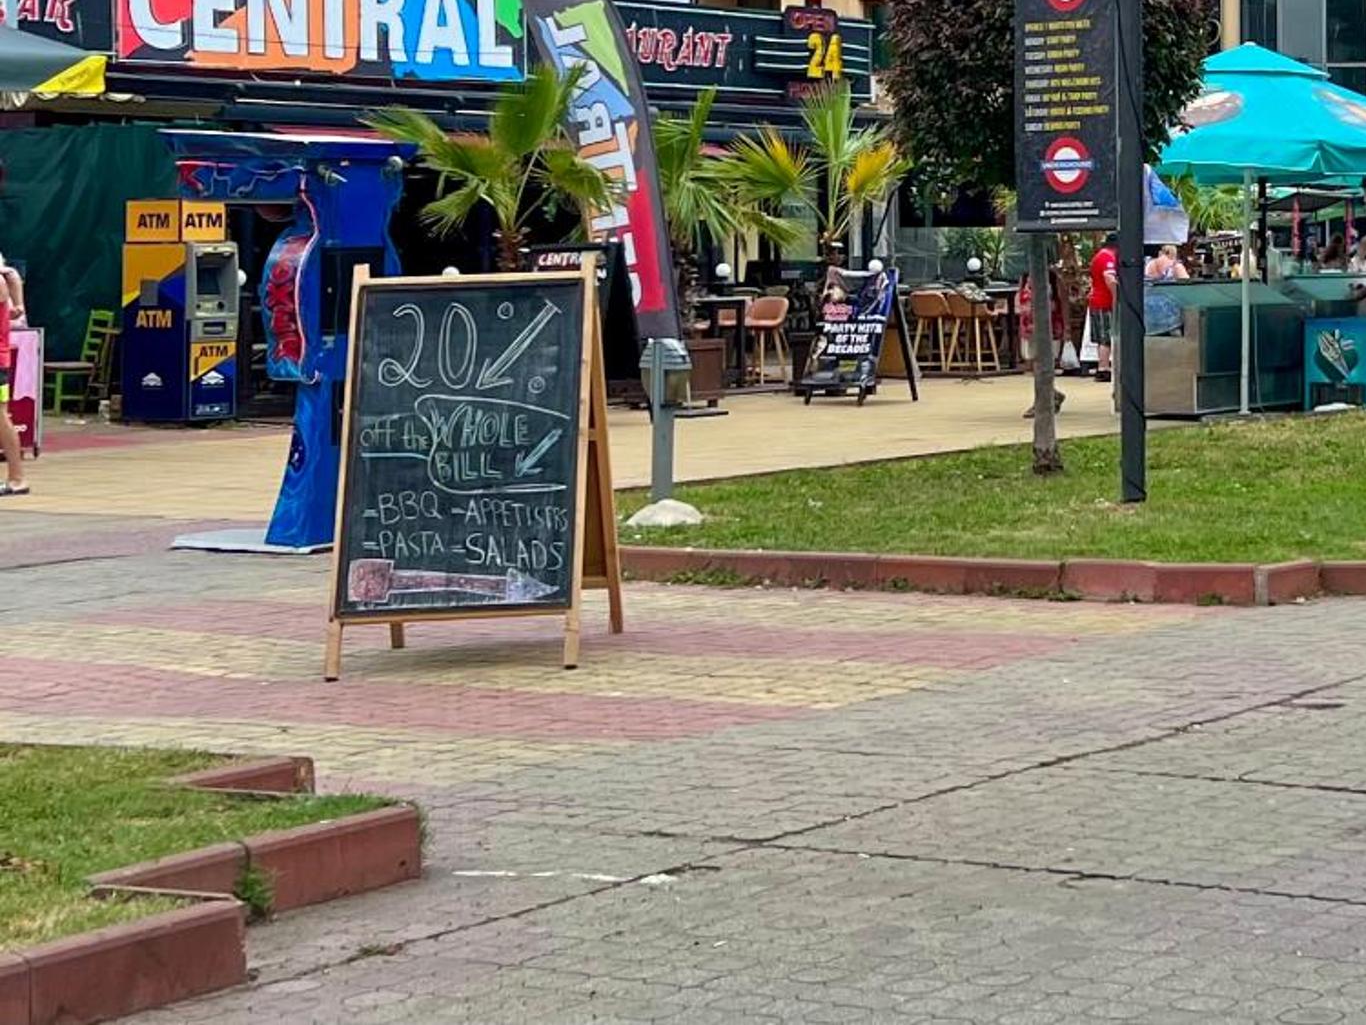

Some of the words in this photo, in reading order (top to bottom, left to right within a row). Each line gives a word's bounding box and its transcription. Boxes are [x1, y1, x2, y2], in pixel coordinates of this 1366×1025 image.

[806, 31, 842, 79] 24
[137, 213, 170, 229] ATM
[185, 213, 224, 229] ATM
[135, 310, 172, 329] ATM
[199, 345, 229, 357] ATM
[427, 401, 531, 448] WHOLE
[434, 451, 503, 482] BILL
